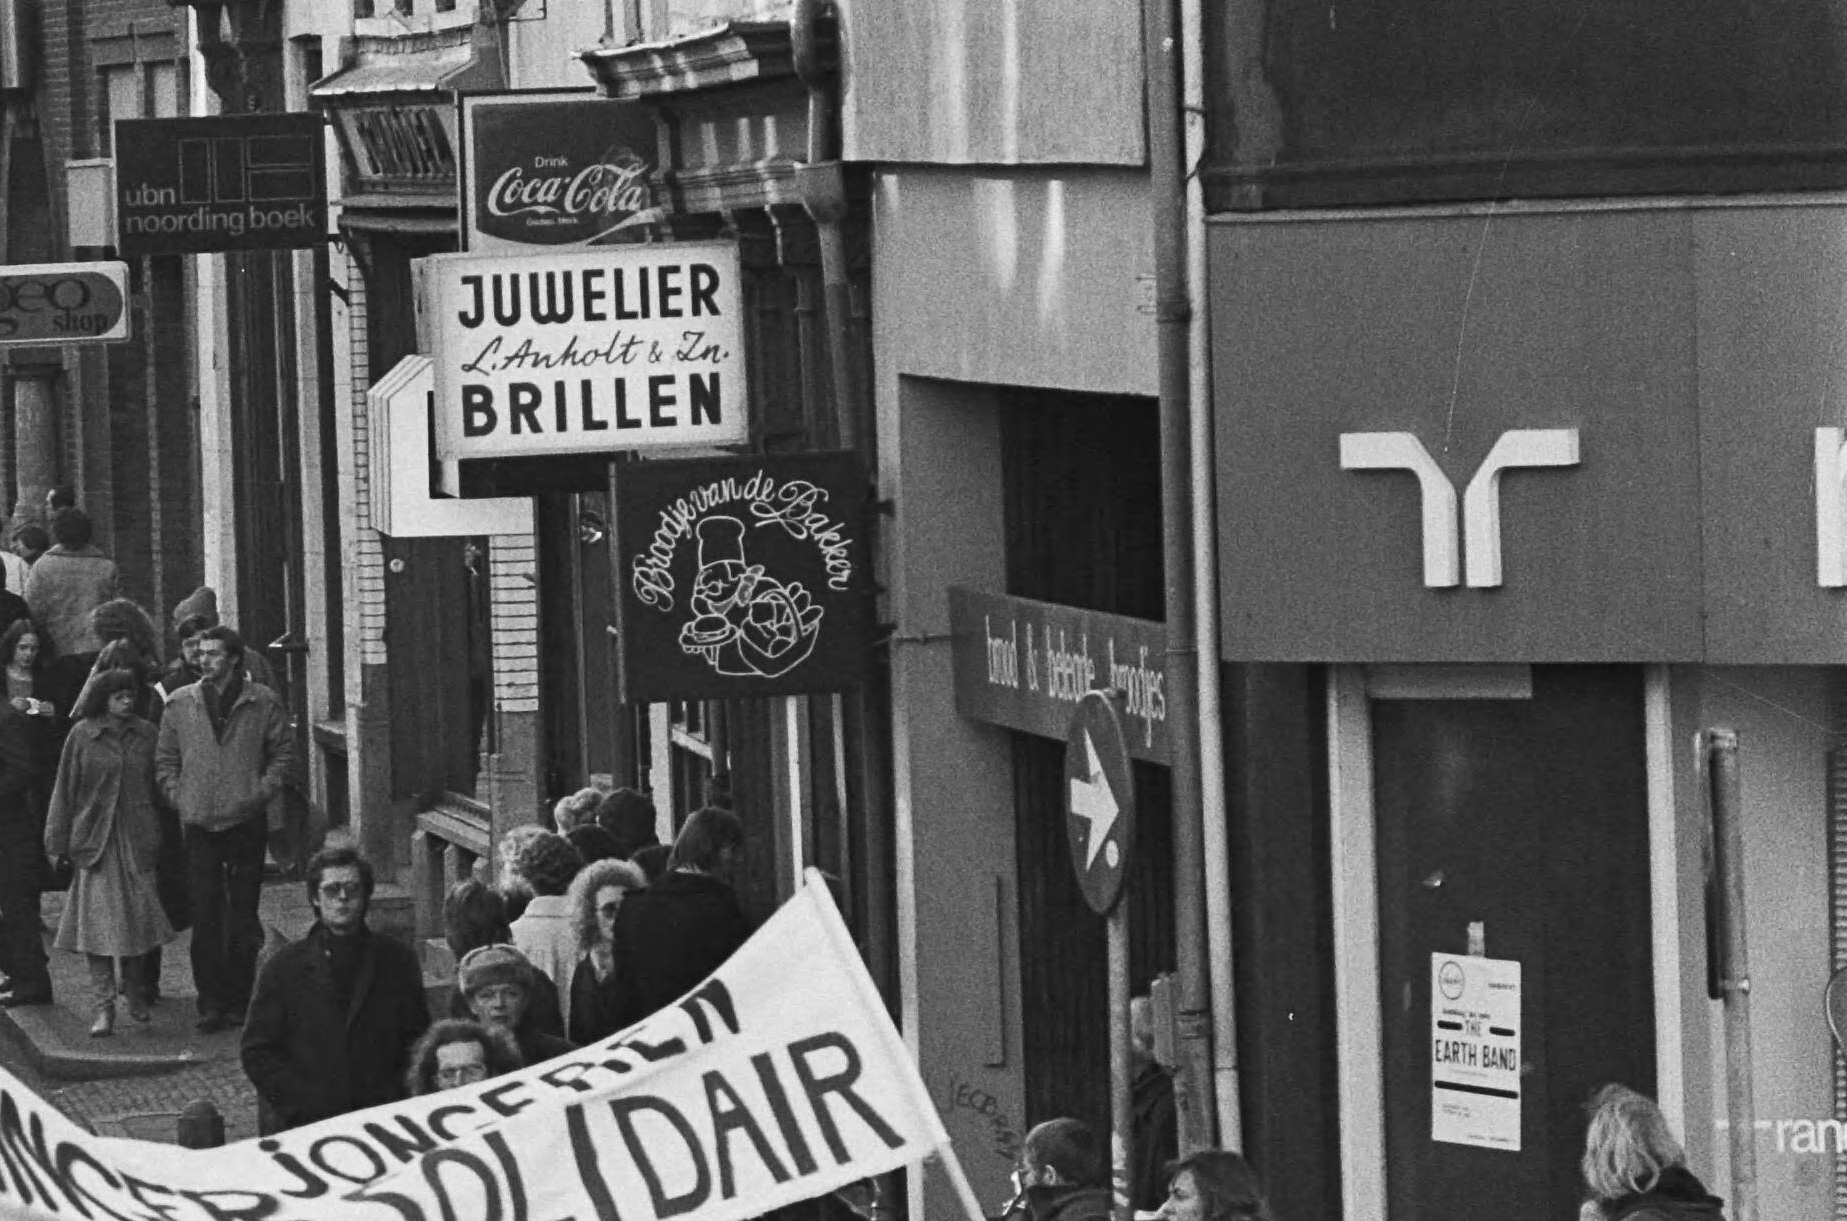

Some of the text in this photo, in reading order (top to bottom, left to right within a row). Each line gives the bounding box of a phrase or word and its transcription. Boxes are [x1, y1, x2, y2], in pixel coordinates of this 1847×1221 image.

[534, 156, 568, 168] Drink
[125, 182, 175, 206] ubn
[126, 202, 315, 237] noording boek
[457, 262, 722, 329] JUWELIER
[52, 308, 107, 336] shop
[648, 340, 662, 362] &
[678, 330, 731, 365] Zn.
[460, 371, 723, 438] BRILLEN
[689, 476, 743, 513] van
[742, 467, 776, 502] de
[749, 479, 854, 591] Bakker
[985, 614, 1020, 690] brood
[1465, 1020, 1483, 1038] THE
[1434, 1039, 1517, 1072] EARTH BAND
